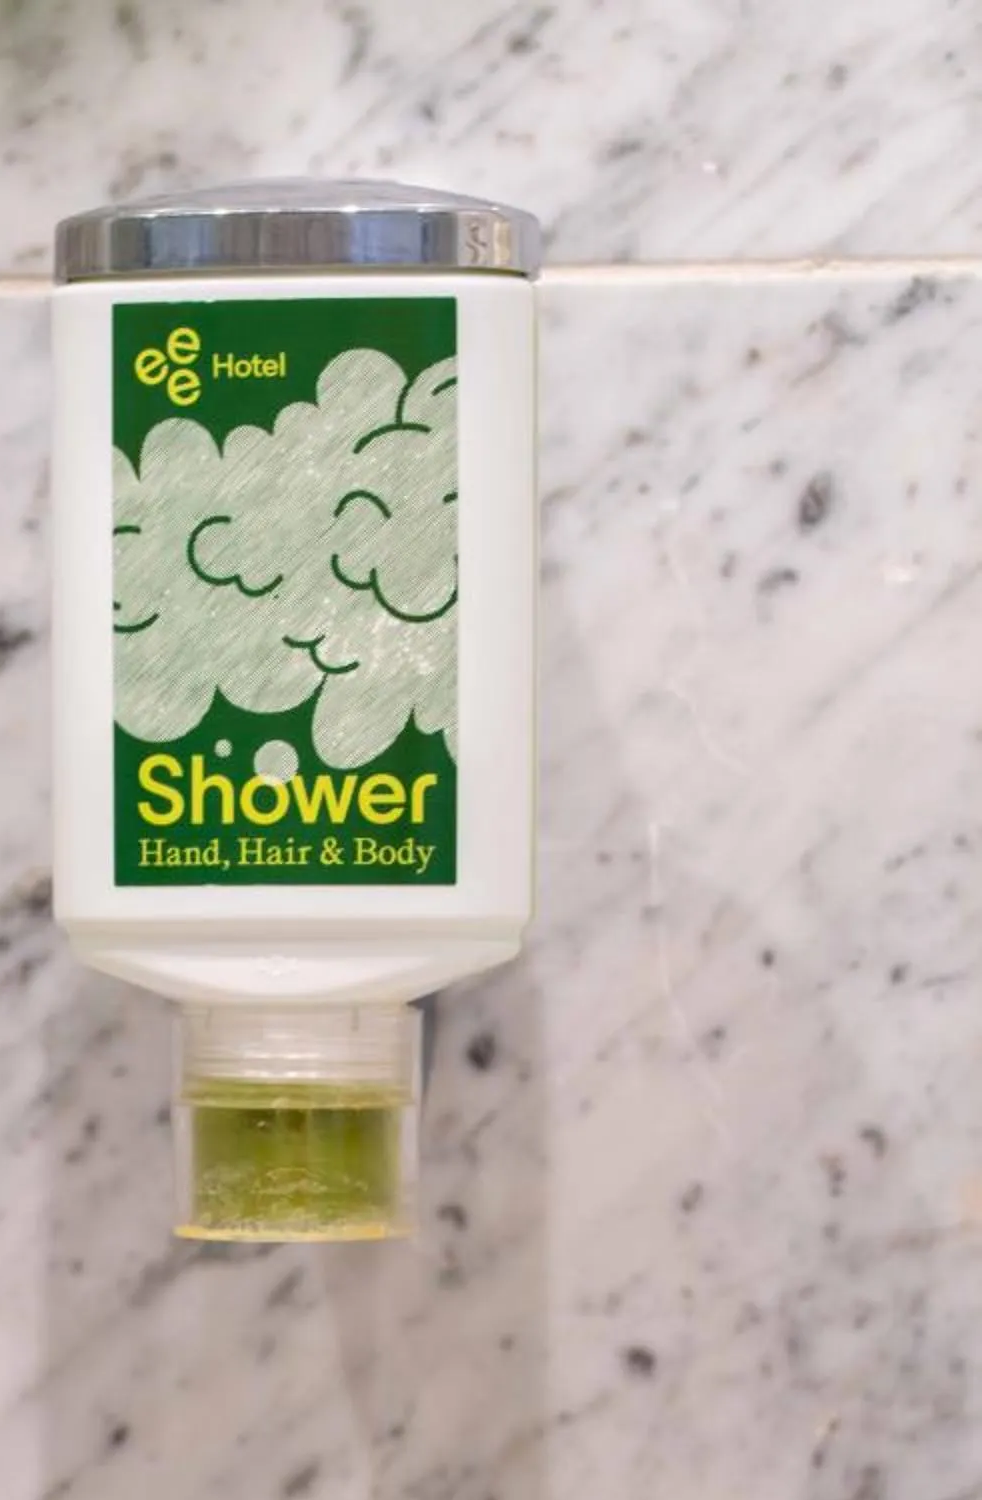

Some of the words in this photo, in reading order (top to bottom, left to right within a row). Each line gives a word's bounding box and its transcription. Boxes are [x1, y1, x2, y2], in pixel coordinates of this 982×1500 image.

[212, 352, 287, 378] Hotel
[137, 753, 438, 826] Shower
[138, 838, 230, 870] Hand,
[237, 837, 313, 866] Hair
[319, 836, 345, 866] &
[353, 836, 437, 874] Body
